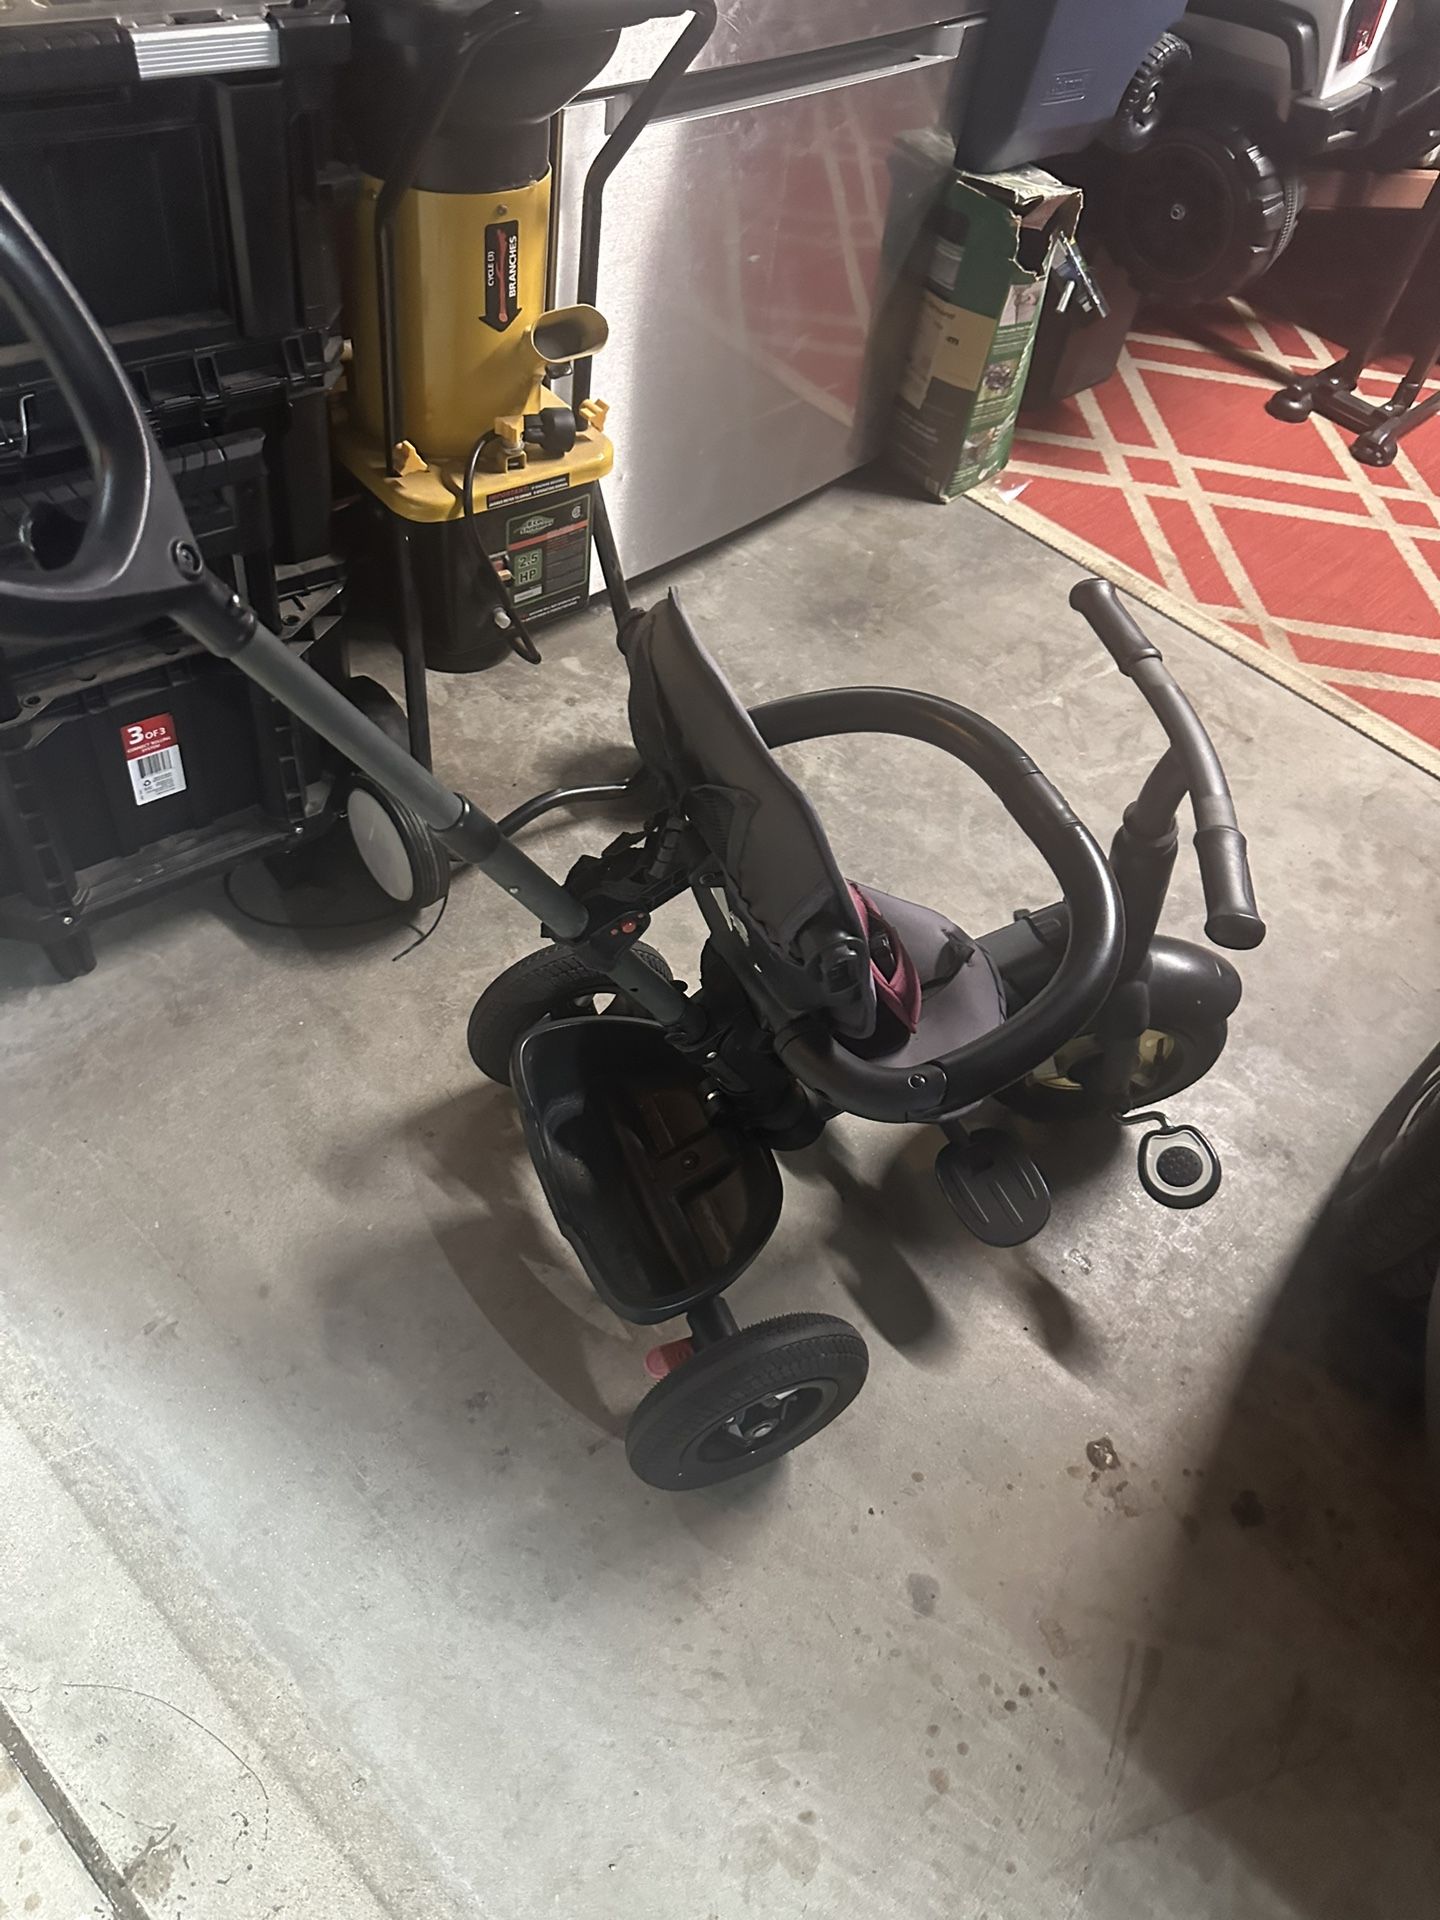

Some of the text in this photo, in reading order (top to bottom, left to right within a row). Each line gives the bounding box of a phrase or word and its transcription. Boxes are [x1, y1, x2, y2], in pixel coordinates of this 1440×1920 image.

[487, 263, 495, 287] CYCLE
[508, 235, 517, 298] BRANCHES
[519, 553, 538, 568] 2.5
[519, 569, 537, 583] HP
[127, 725, 167, 745] 3 OF 3
